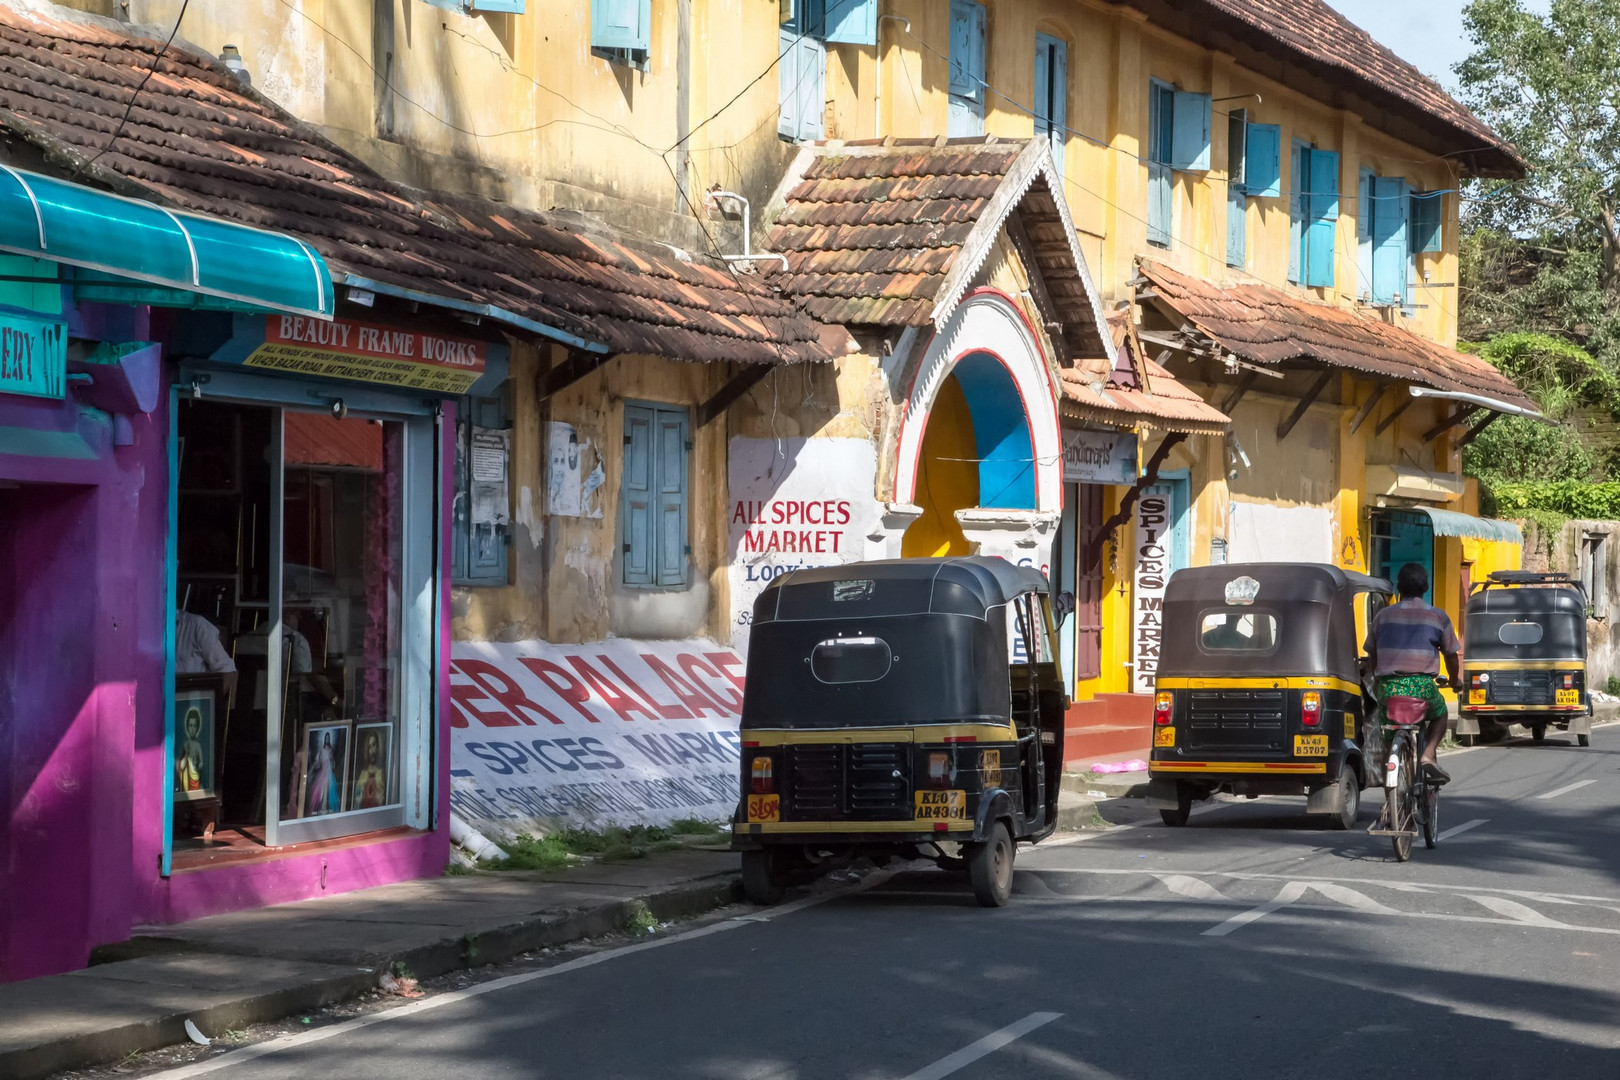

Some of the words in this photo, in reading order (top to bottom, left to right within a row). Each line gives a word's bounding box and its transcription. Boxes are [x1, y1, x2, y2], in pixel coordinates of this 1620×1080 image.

[279, 315, 352, 347] BEAUTY
[357, 326, 415, 357] FRAME
[421, 335, 477, 366] WORKS
[275, 357, 301, 370] BAZAR
[277, 347, 302, 357] KINDS
[301, 350, 313, 358] OF
[311, 351, 334, 361] WOOD
[356, 358, 371, 366] AND
[370, 360, 394, 369] GLASS
[392, 362, 417, 372] WORKS
[733, 501, 767, 525] ALL
[771, 501, 851, 525] SPICES
[744, 530, 844, 553] MARKET
[1138, 498, 1165, 591] SPICES
[516, 651, 746, 723] PALACE
[464, 736, 625, 775] SPICES
[558, 782, 645, 814] RETAIL
